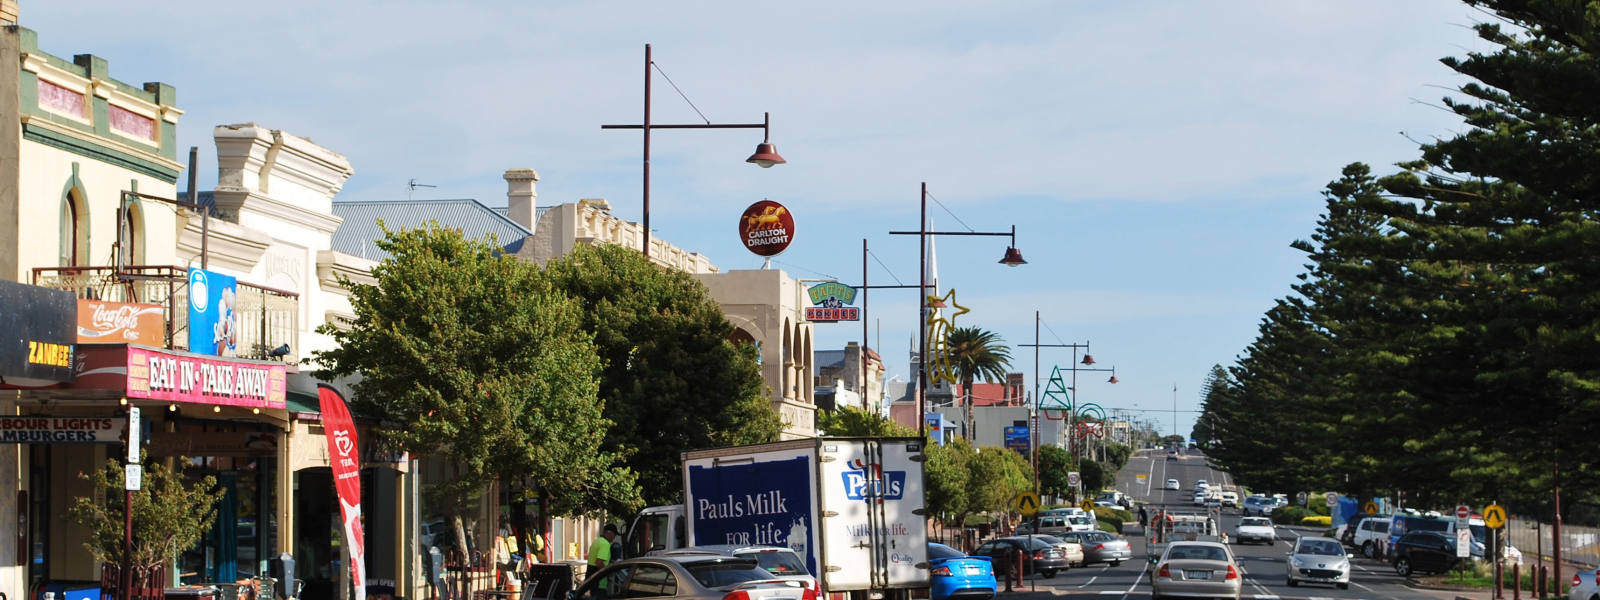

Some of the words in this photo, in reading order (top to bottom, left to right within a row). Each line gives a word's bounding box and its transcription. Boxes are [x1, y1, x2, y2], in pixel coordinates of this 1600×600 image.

[747, 235, 789, 247] DRAUGHT
[748, 228, 786, 239] CARLTON
[812, 285, 852, 300] TATTS
[149, 357, 177, 390] EAT
[201, 362, 234, 396] TAKE
[236, 367, 269, 398] AWAY
[0, 418, 49, 430] BOUR
[53, 418, 112, 430] LIGHTS
[847, 473, 901, 497] Pauls
[698, 495, 744, 520] Pauls
[746, 490, 788, 516] Milk
[726, 531, 751, 546] FOR
[753, 522, 786, 545] life.
[846, 524, 872, 537] Milk
[892, 523, 910, 536] life.
